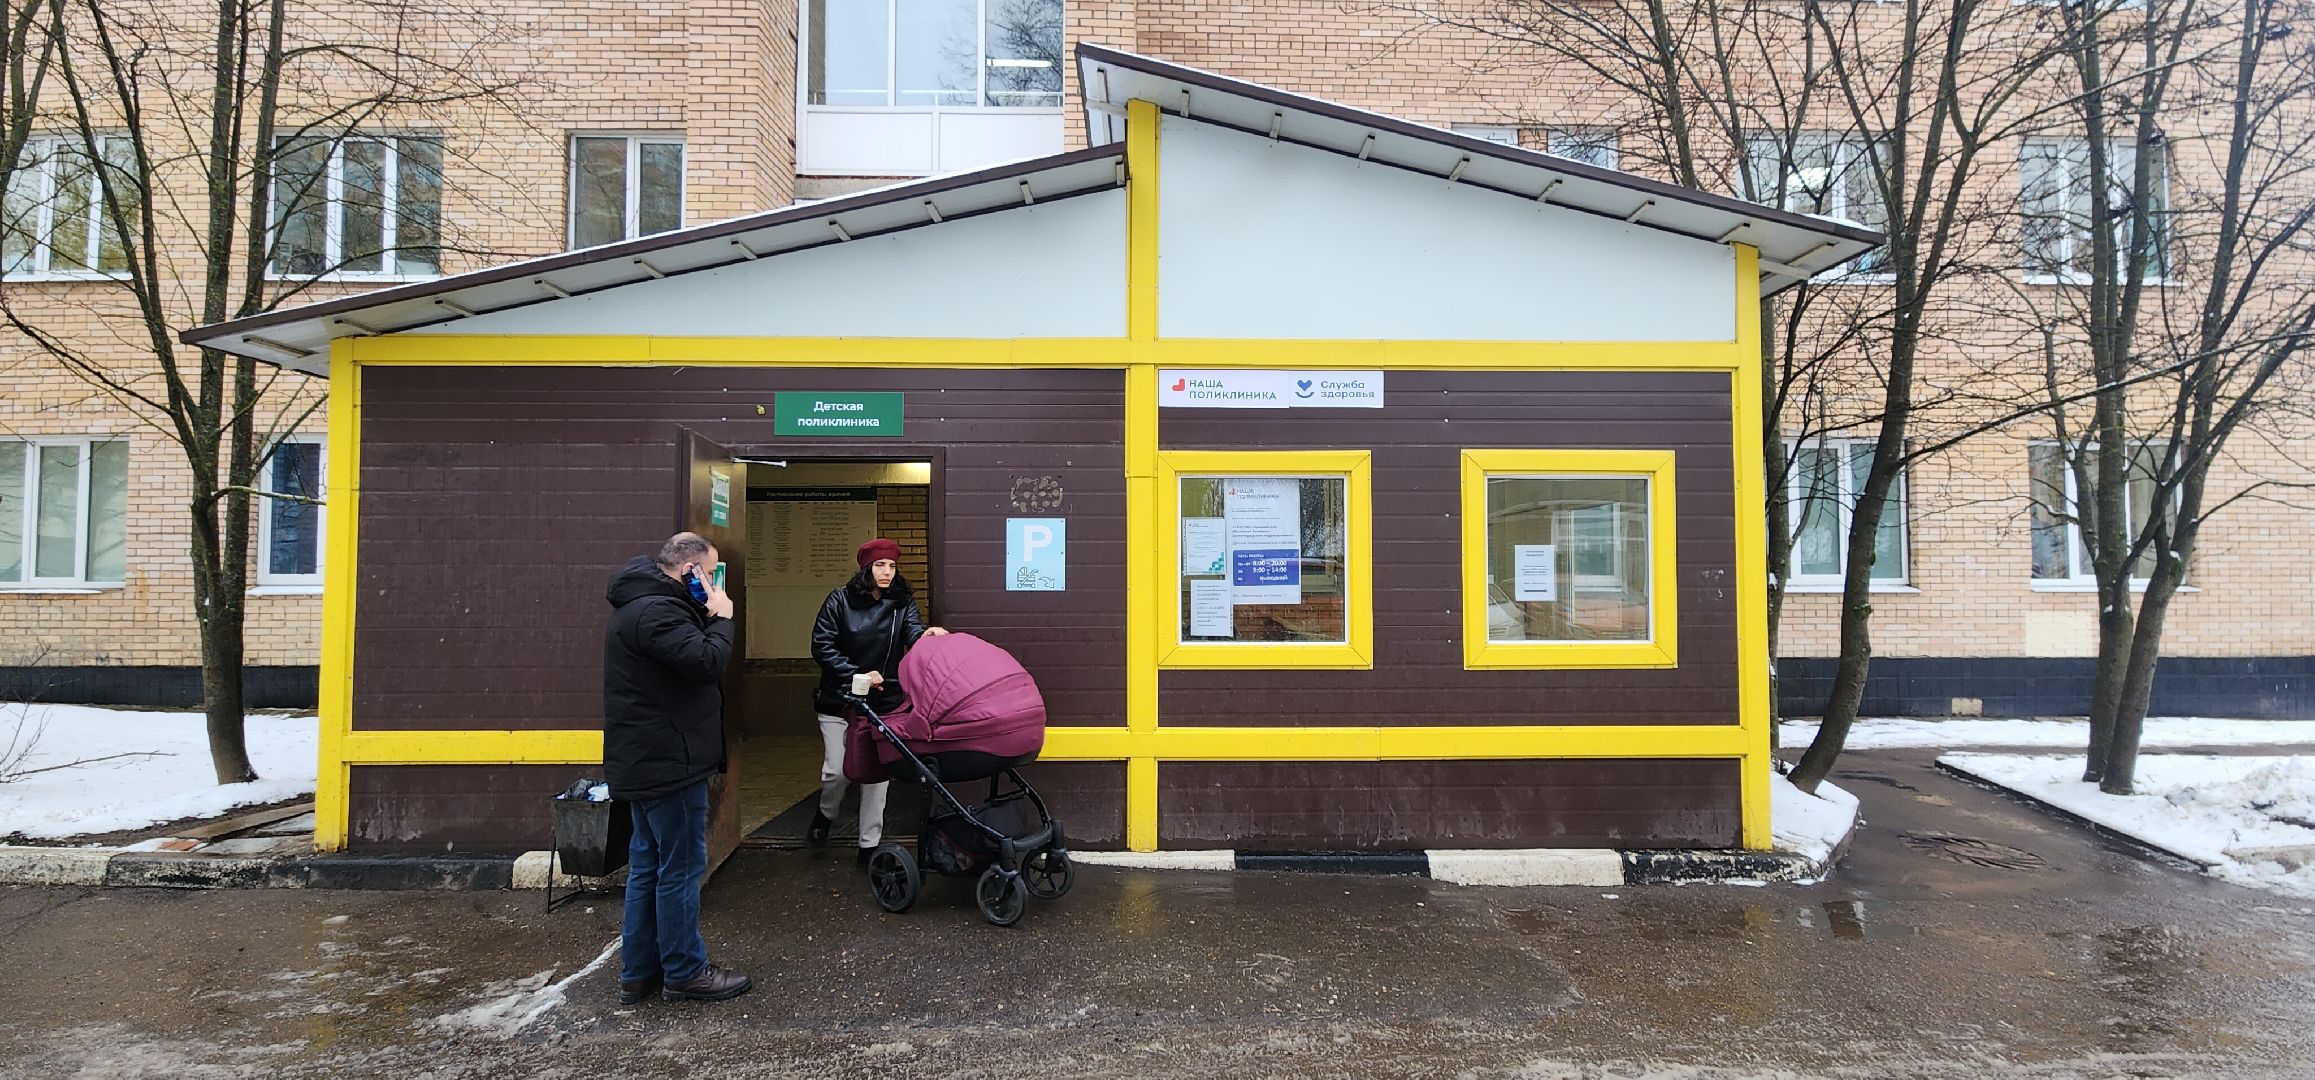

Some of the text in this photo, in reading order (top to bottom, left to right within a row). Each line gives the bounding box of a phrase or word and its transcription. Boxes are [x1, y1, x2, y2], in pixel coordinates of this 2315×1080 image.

[1189, 379, 1224, 388] НАША
[1320, 380, 1365, 390] Служба
[1189, 390, 1277, 400] ПОЛИКЛИНИКА
[1320, 391, 1375, 399] здоровья
[813, 401, 864, 412] Детская
[797, 418, 880, 427] поликлиника
[1023, 525, 1053, 562] P
